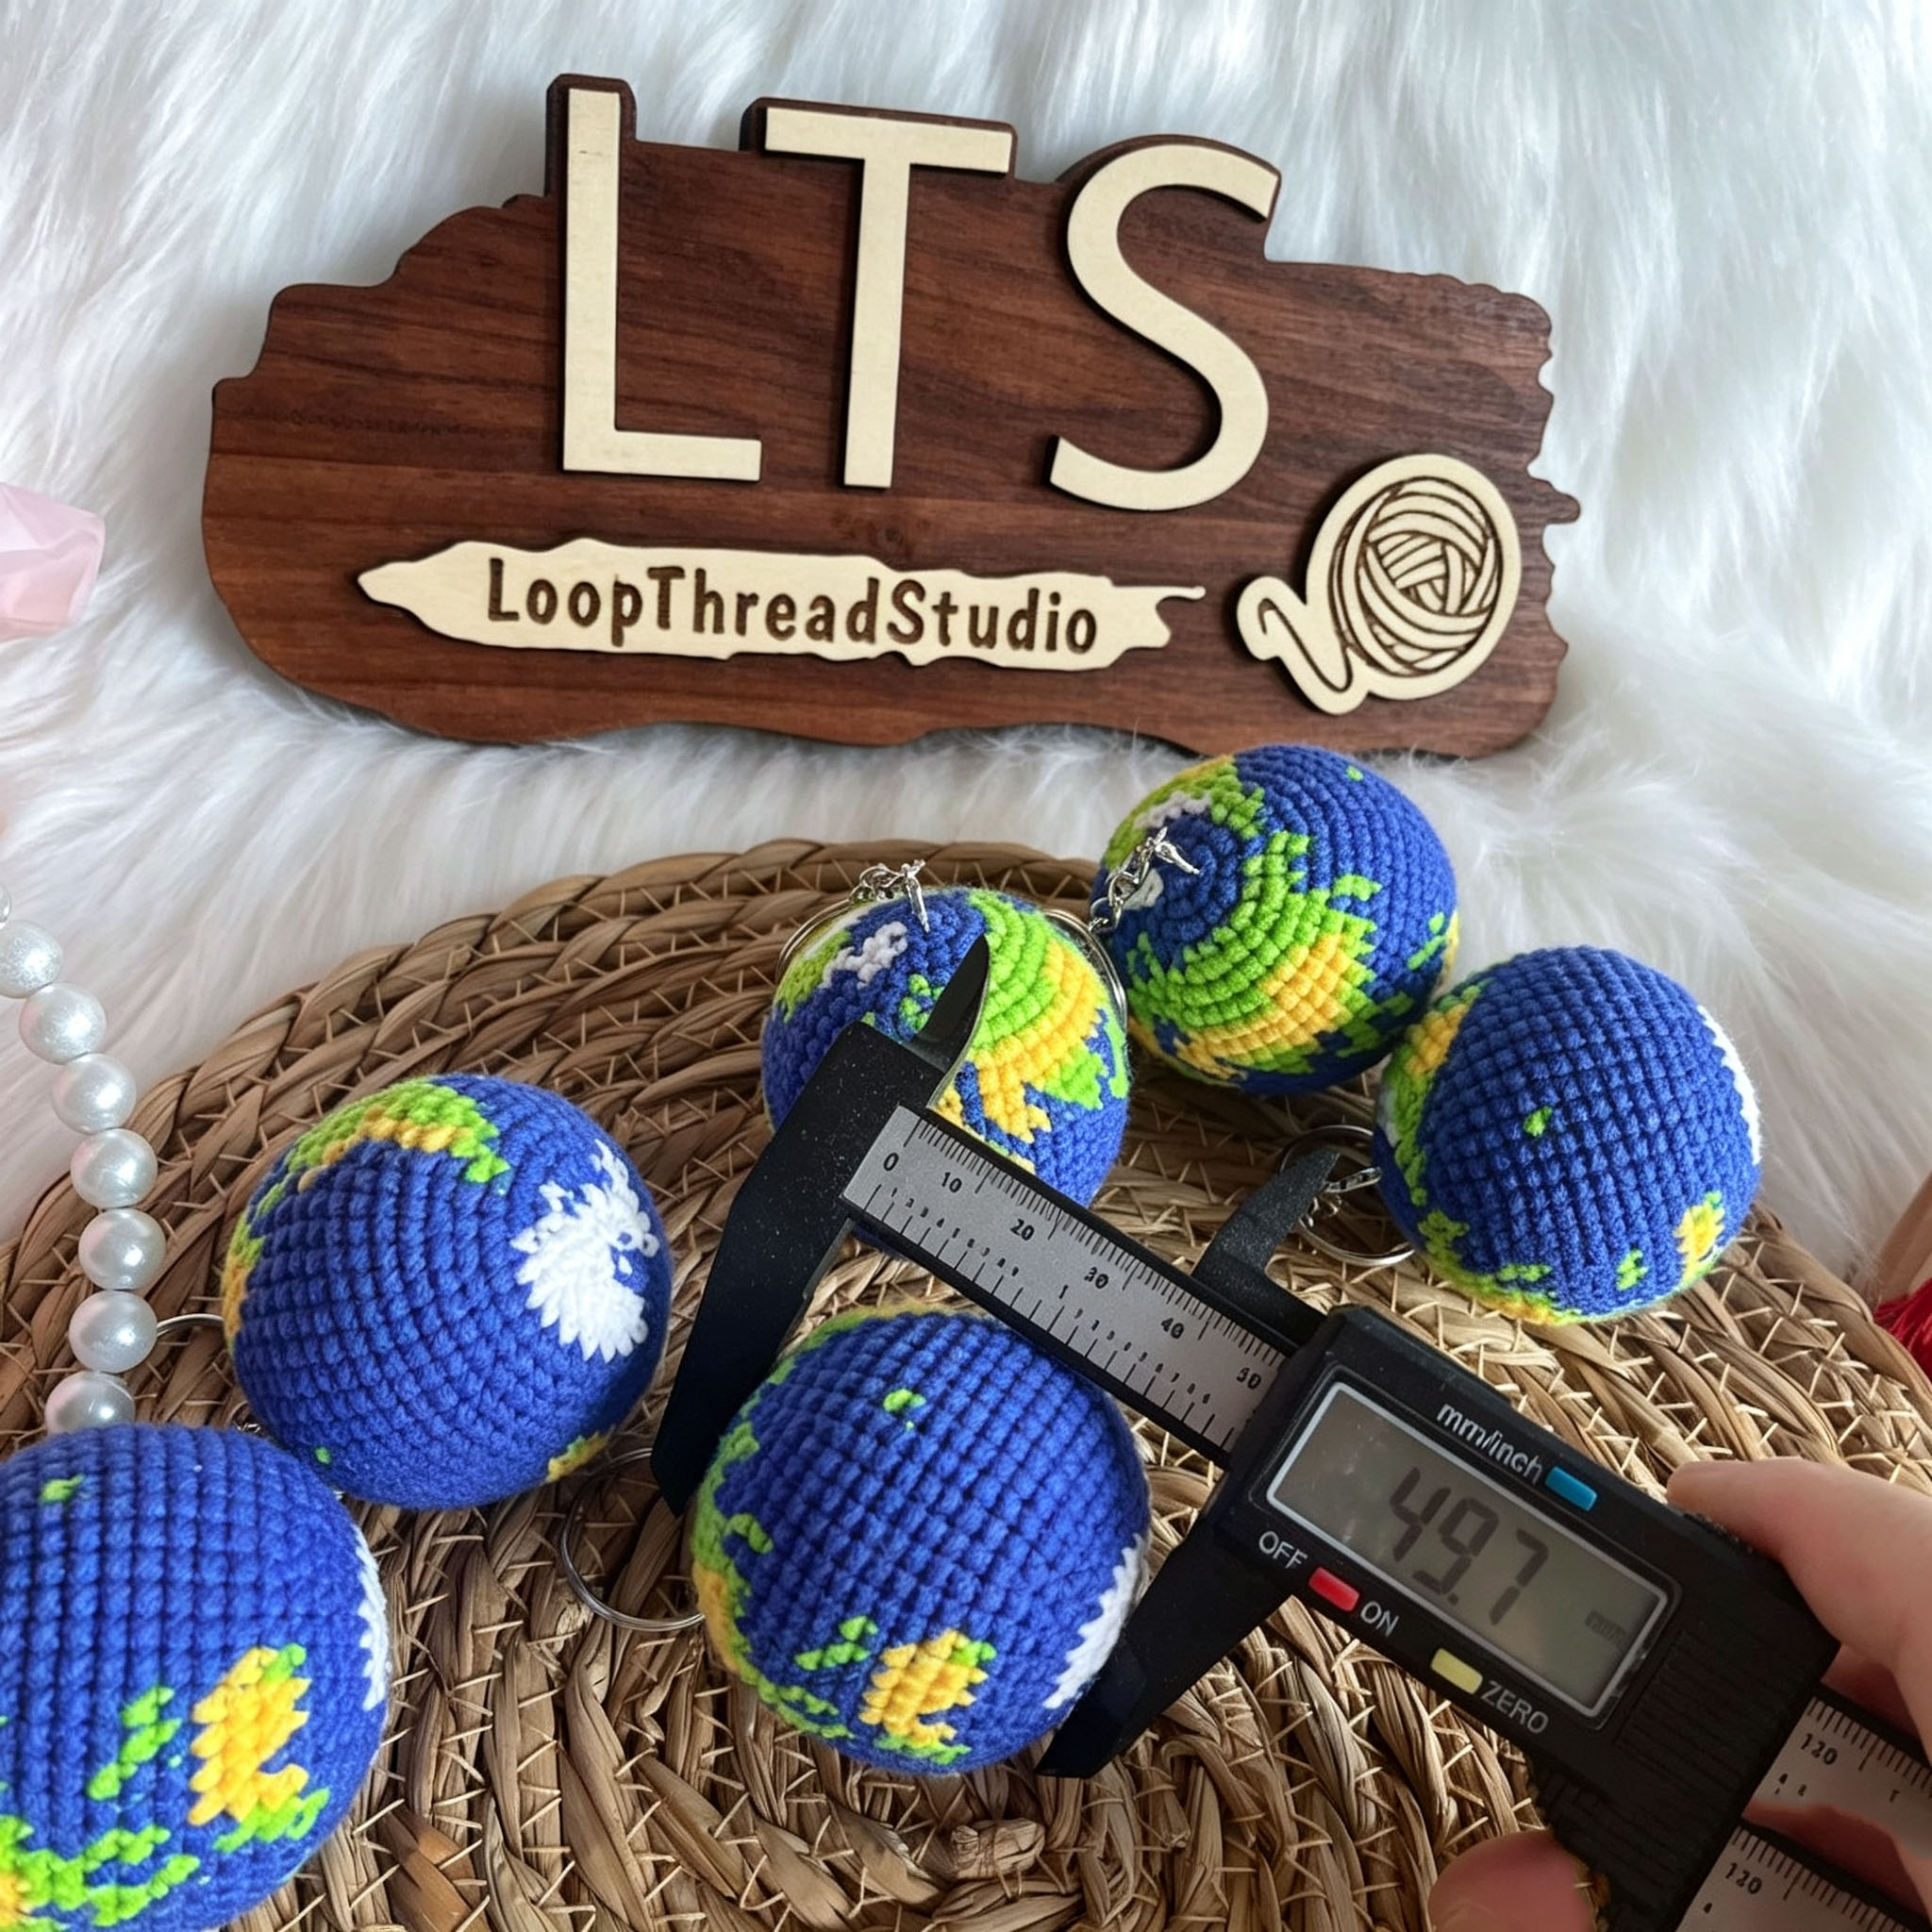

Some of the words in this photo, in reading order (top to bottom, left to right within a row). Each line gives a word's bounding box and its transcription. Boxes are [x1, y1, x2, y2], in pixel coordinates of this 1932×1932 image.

[561, 88, 1279, 510] LTS
[487, 557, 1098, 655] LoopThreadStudio
[883, 1153, 899, 1171] 0
[941, 1172, 962, 1193] 10
[1009, 1218, 1035, 1241] 20
[1083, 1266, 1109, 1290] 30
[1160, 1317, 1185, 1340] 40
[1436, 1404, 1543, 1485] mm/inch
[1258, 1530, 1309, 1569] OFF
[1389, 1467, 1550, 1626] 49.7
[1360, 1601, 1400, 1638] ON
[1480, 1680, 1549, 1734] ZERO
